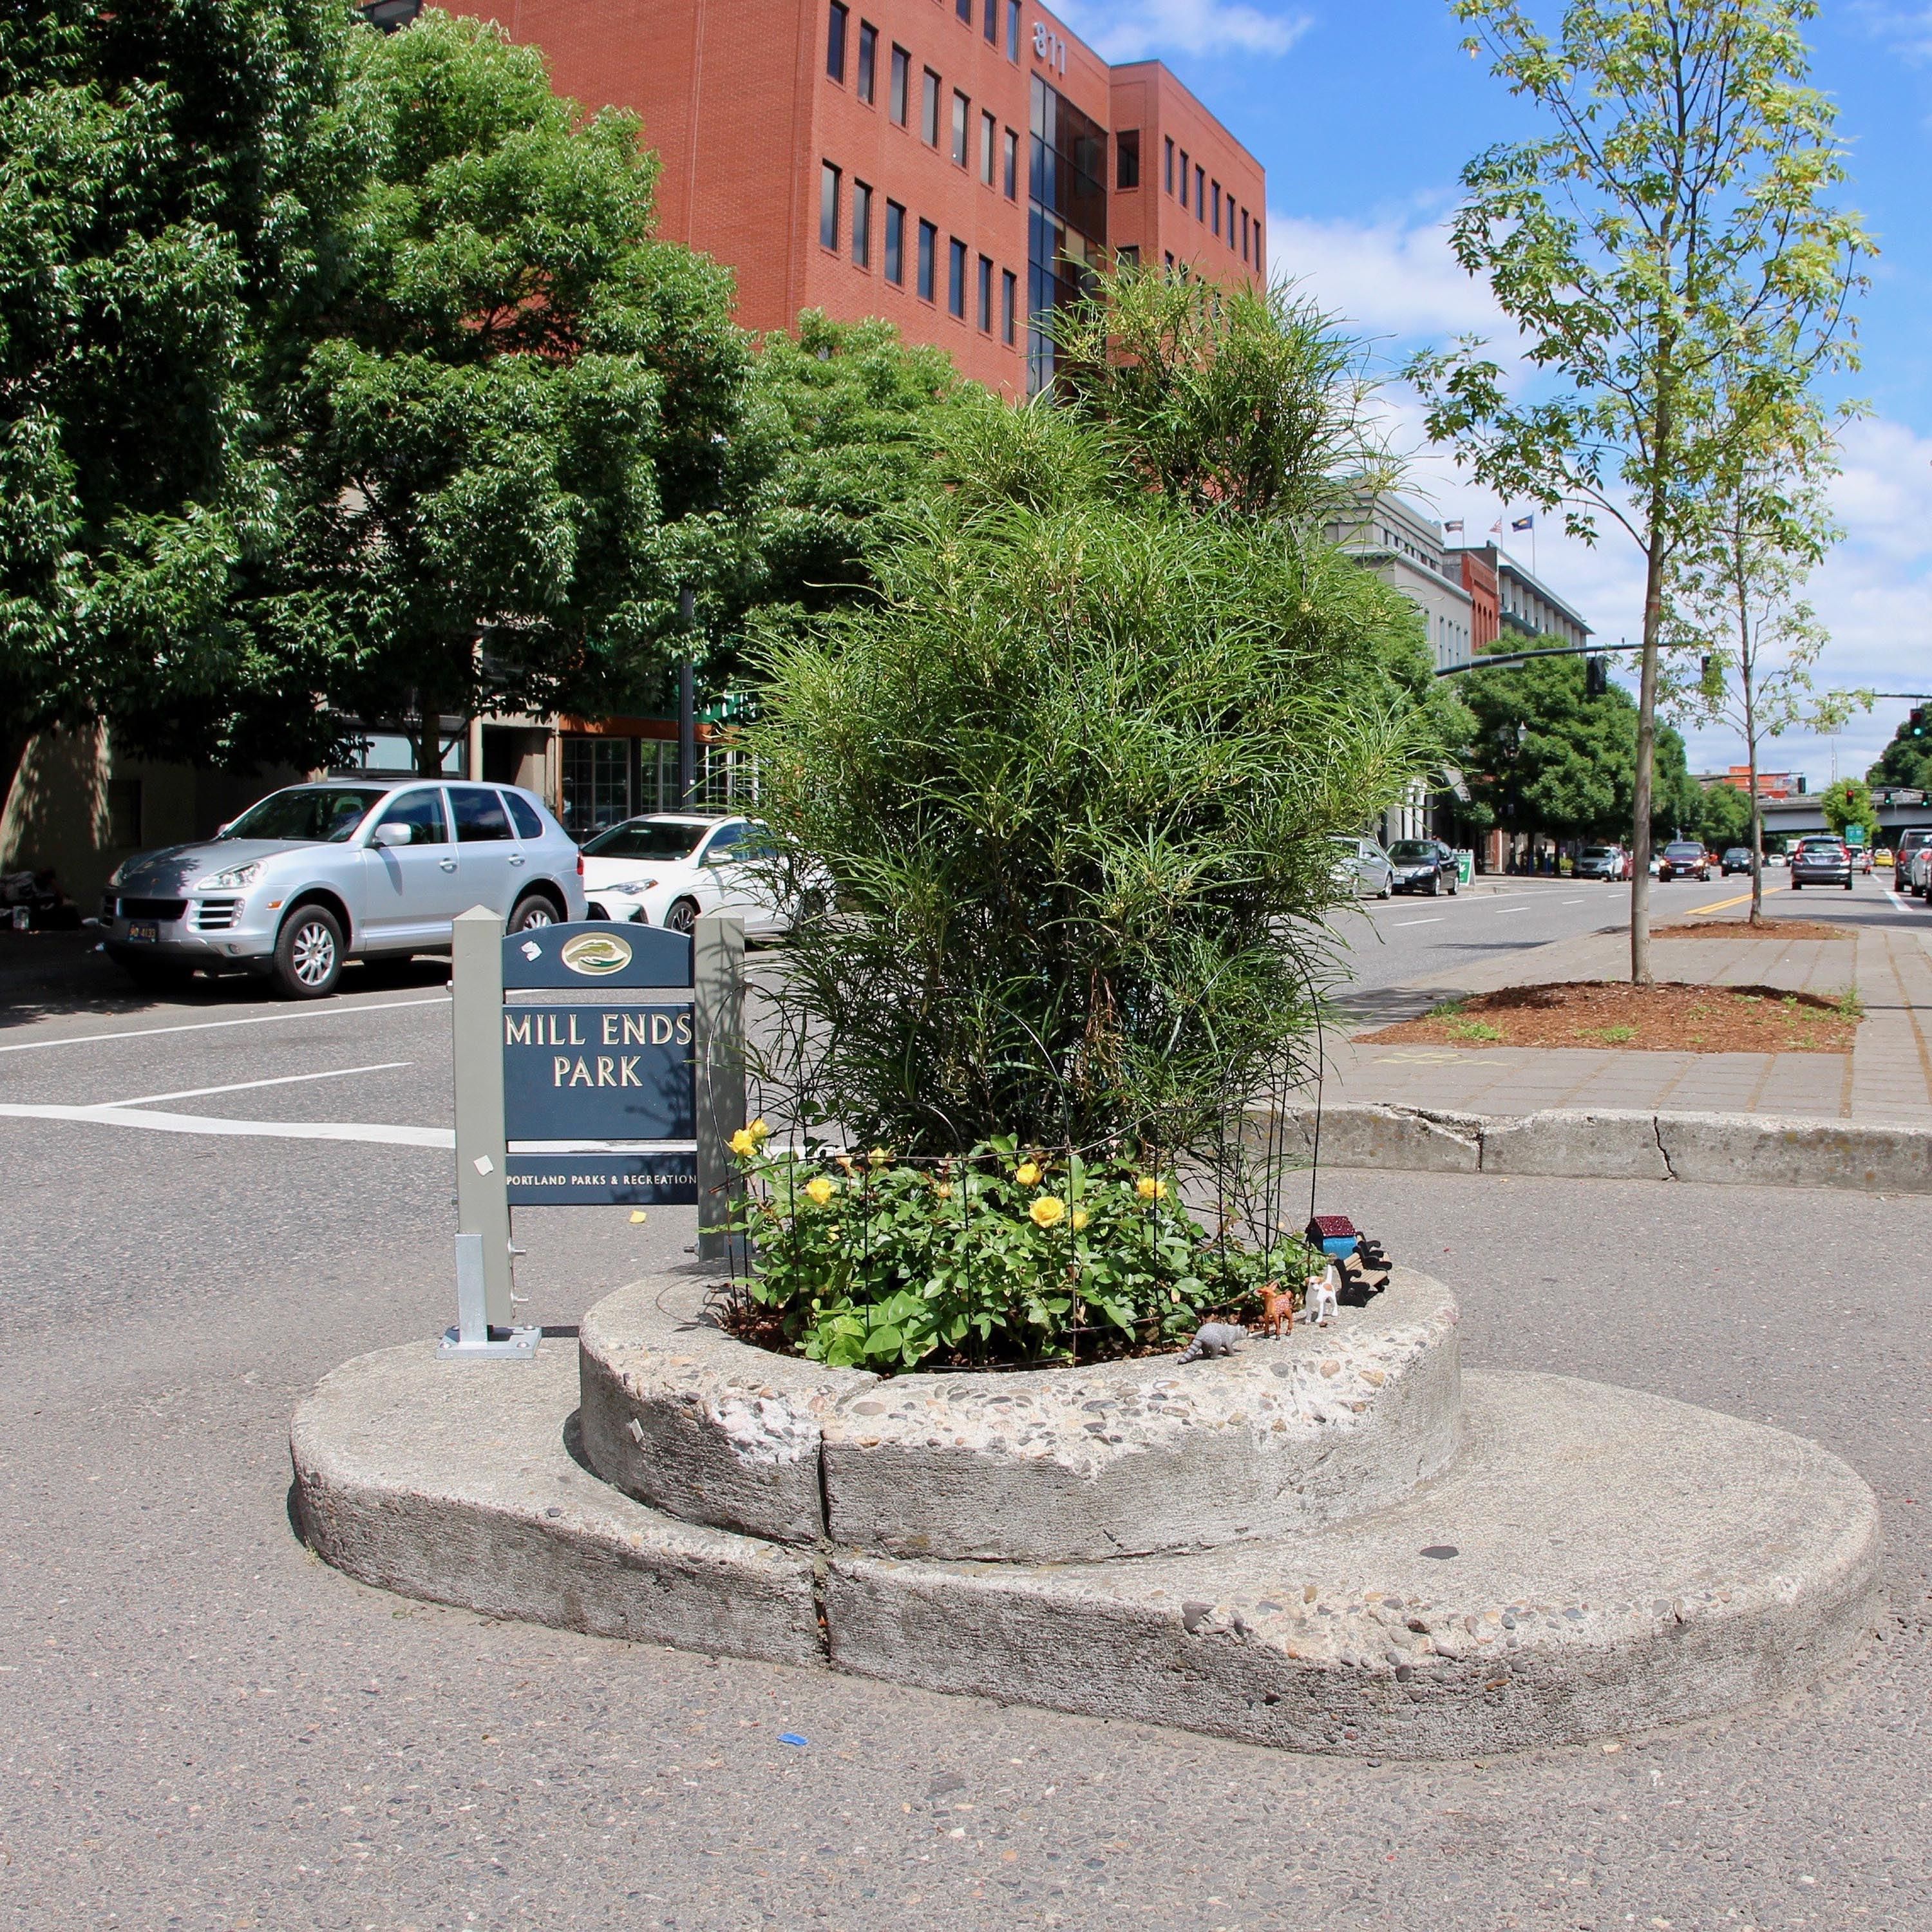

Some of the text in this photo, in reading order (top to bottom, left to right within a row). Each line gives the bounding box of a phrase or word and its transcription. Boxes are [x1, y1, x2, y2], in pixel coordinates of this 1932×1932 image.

[1032, 21, 1066, 75] 811
[505, 1014, 692, 1045] MILL ENDS
[554, 1056, 643, 1087] PARK
[506, 1174, 697, 1186] PORTLAND PARKS & RECREATION
